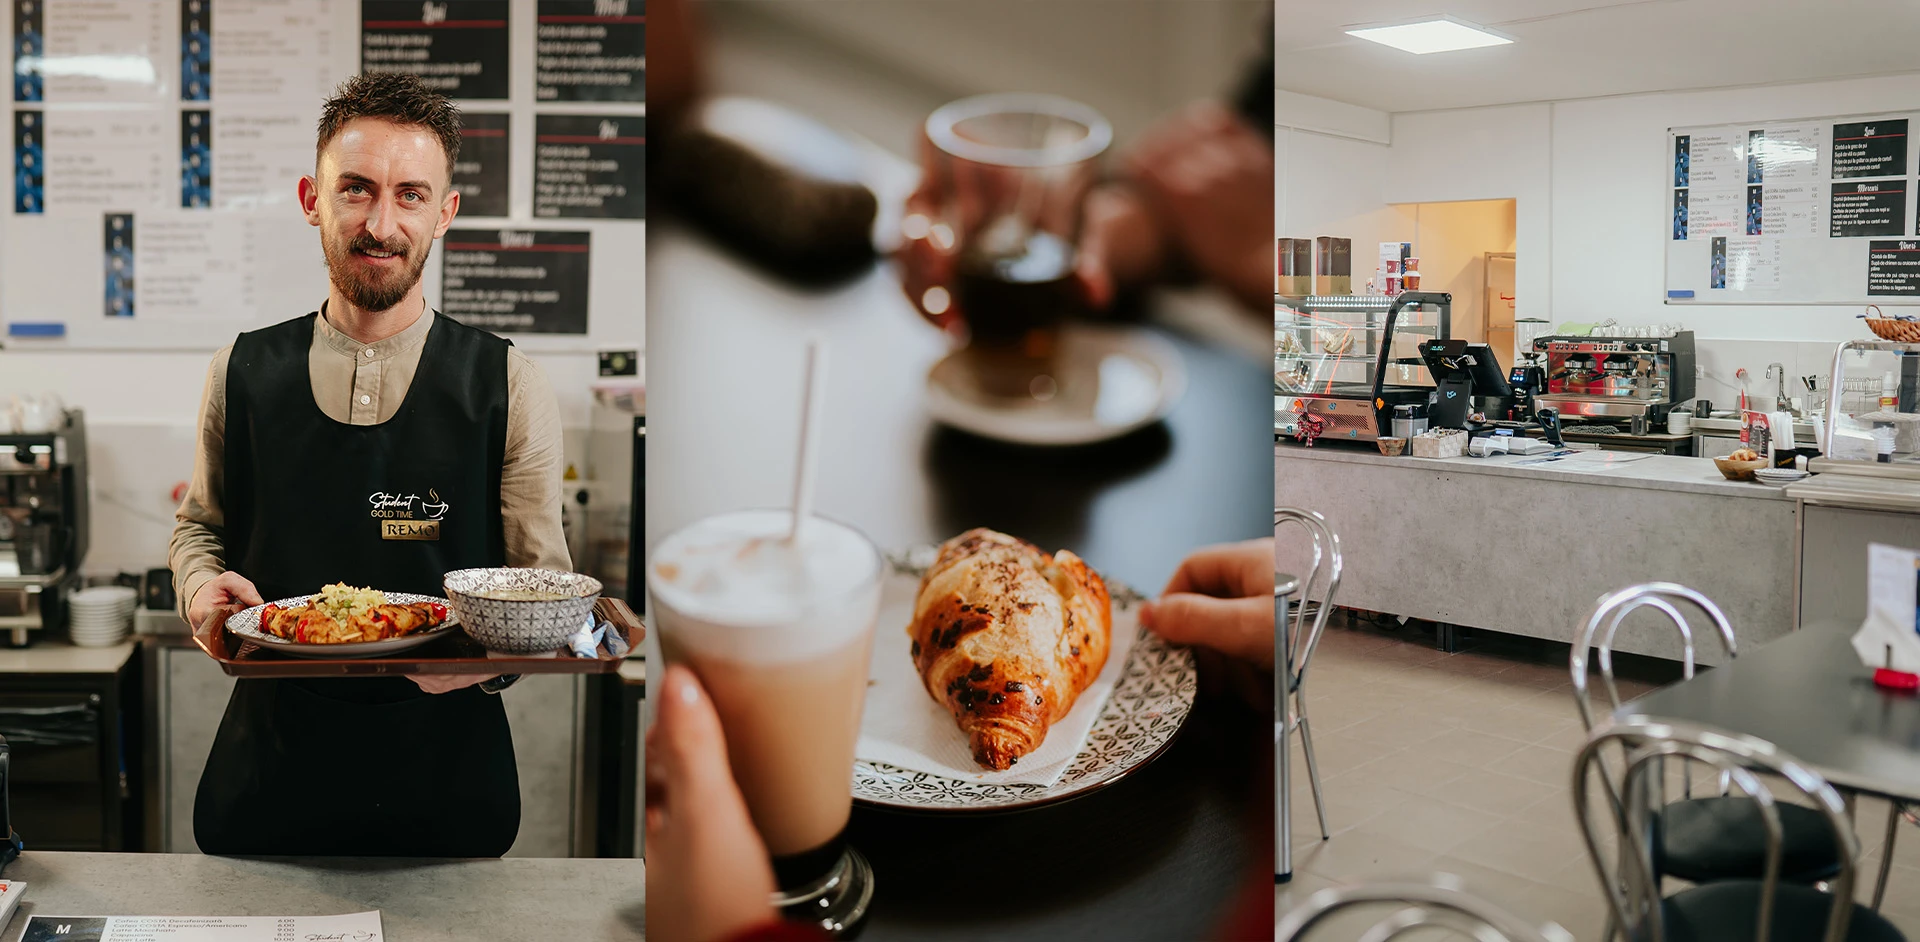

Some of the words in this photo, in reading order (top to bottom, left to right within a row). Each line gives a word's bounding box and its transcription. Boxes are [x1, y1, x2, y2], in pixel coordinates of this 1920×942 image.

[368, 492, 420, 510] Student
[370, 510, 394, 518] GOLD
[387, 524, 434, 536] REMO
